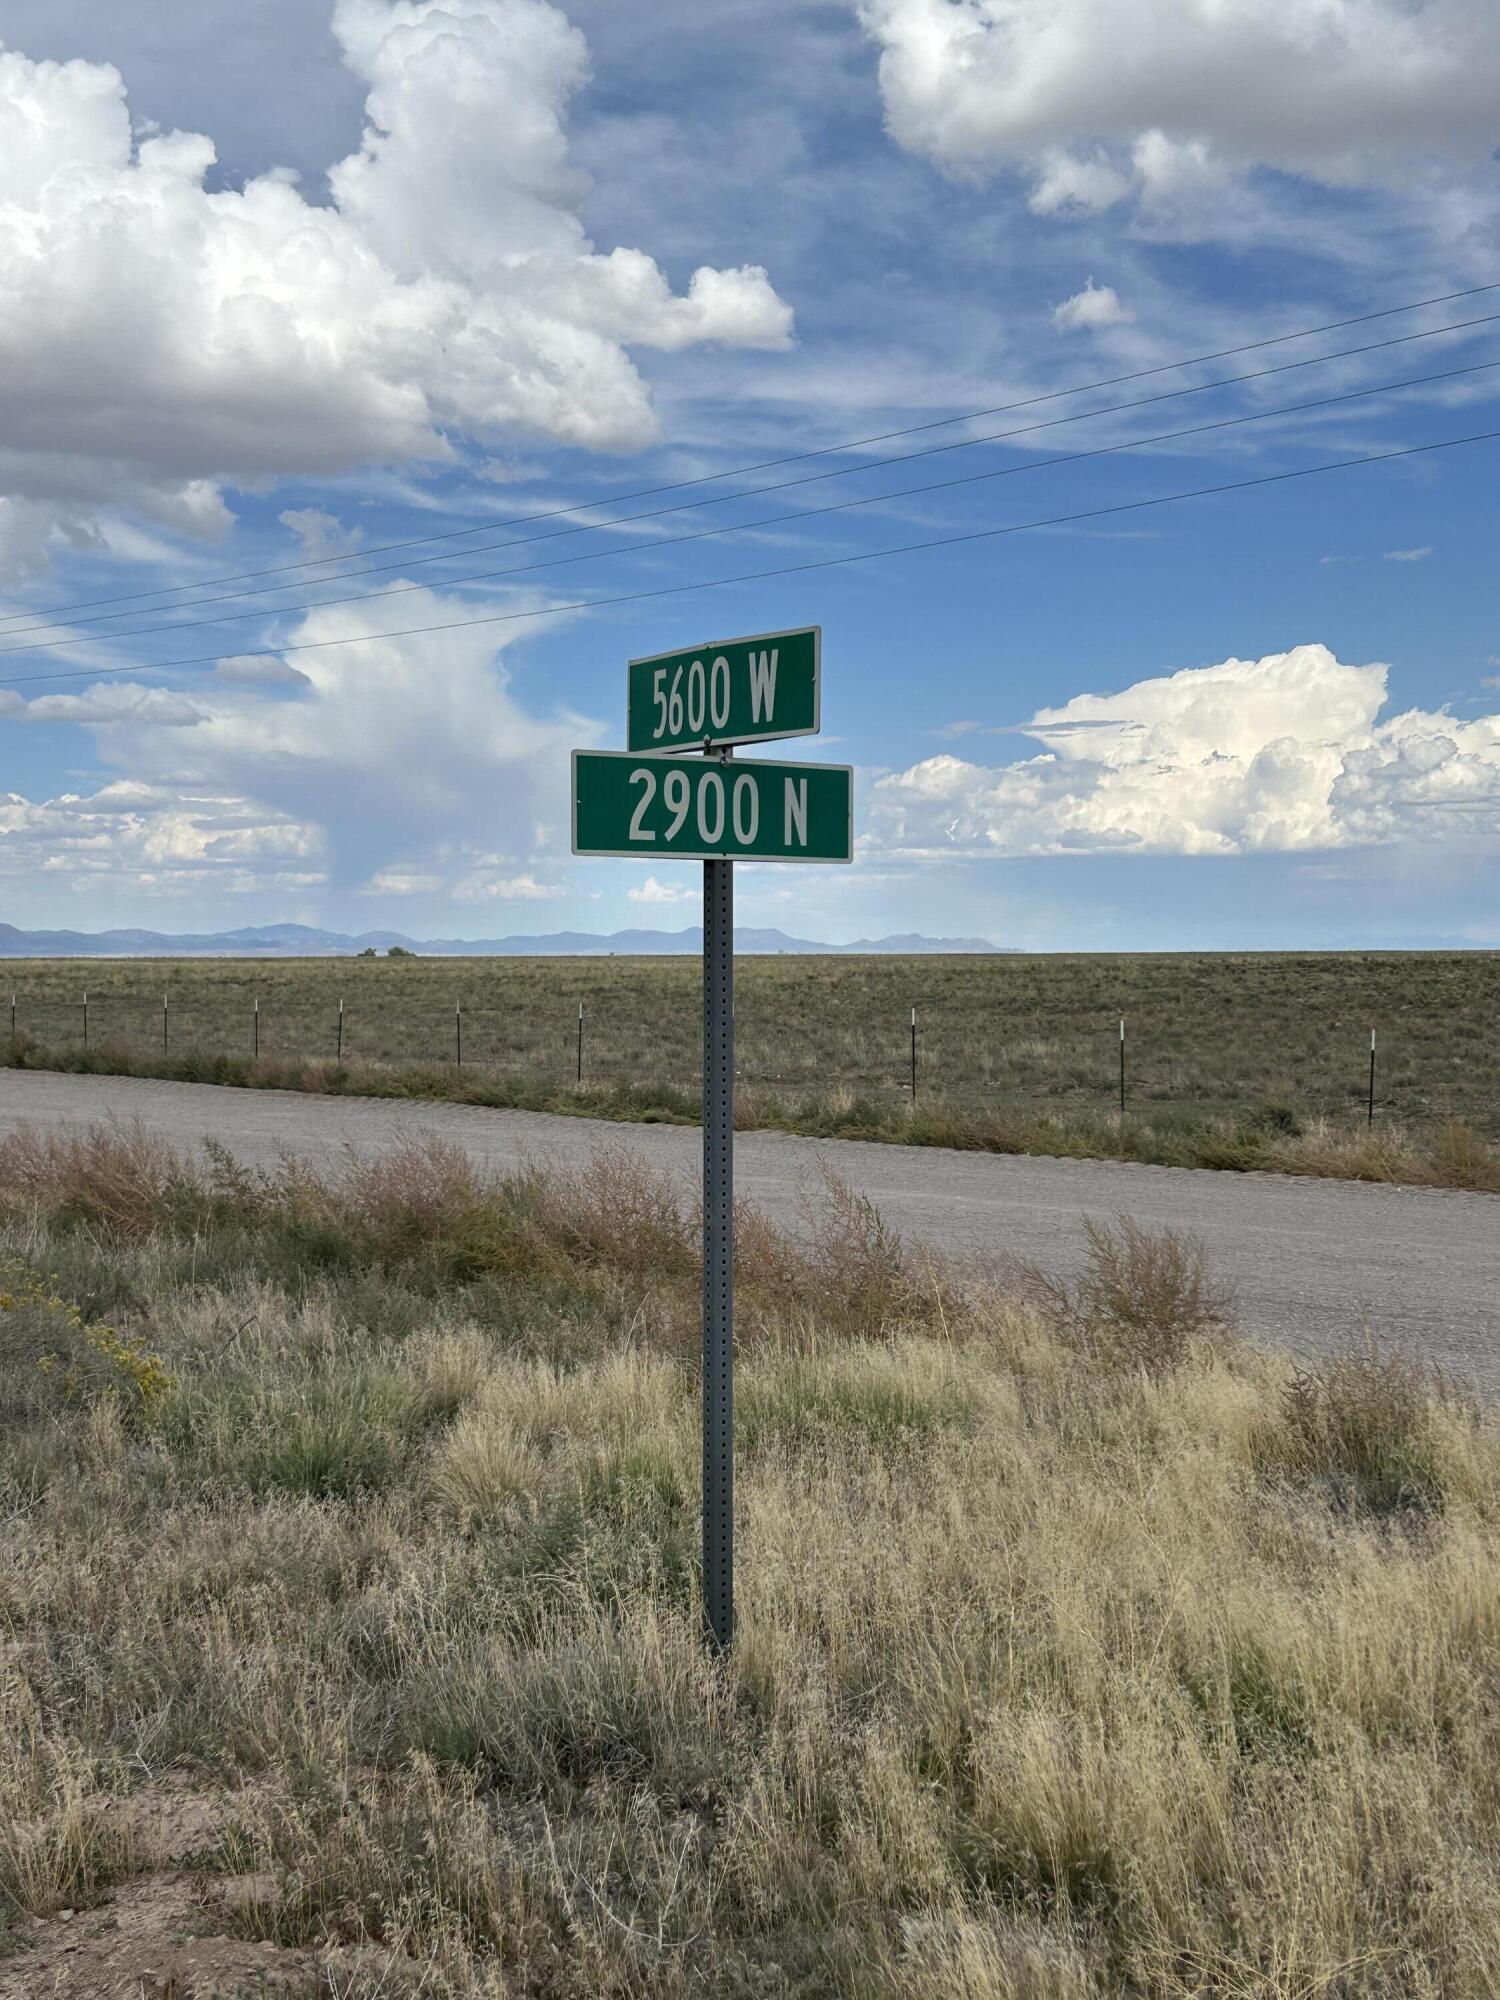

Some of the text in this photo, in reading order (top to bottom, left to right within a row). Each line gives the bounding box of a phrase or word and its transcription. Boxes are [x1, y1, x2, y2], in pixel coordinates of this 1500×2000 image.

[653, 648, 779, 739] 5600 W
[628, 768, 808, 846] 2900 N
